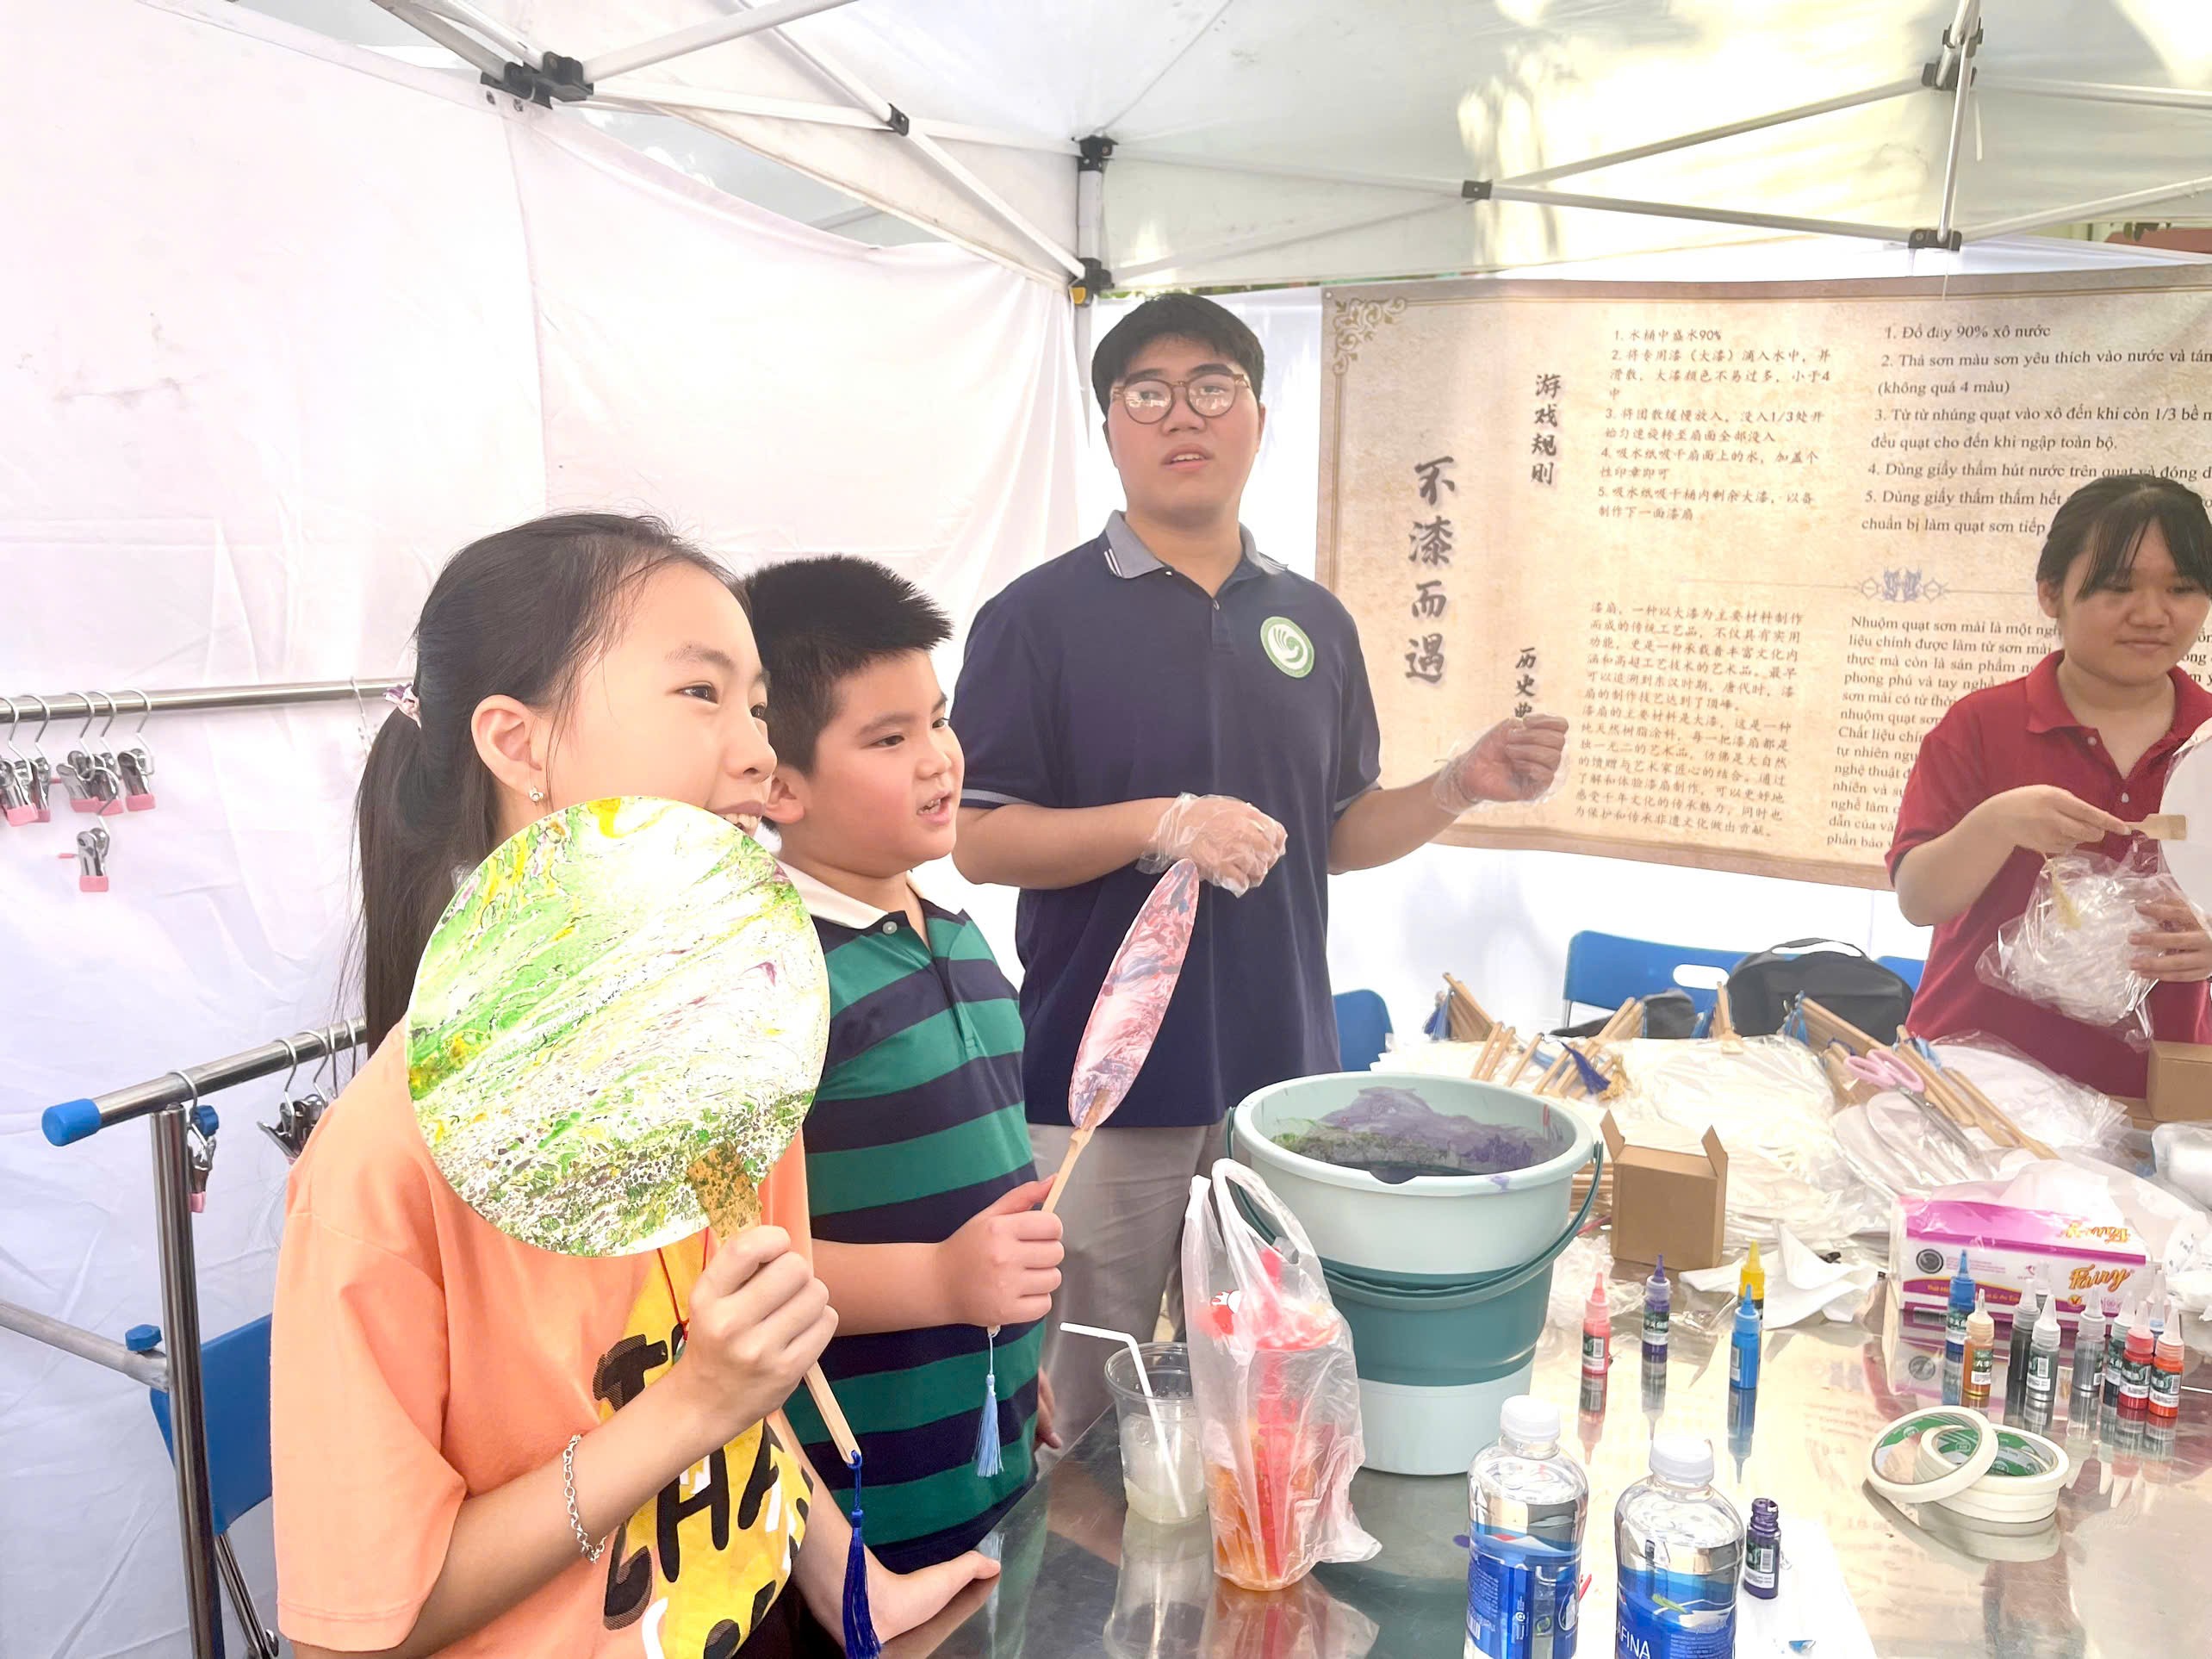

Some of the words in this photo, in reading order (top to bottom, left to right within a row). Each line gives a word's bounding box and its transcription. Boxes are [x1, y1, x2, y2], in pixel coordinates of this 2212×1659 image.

[1886, 326, 1896, 339] 1.
[1957, 325, 1988, 339] 90%
[1992, 324, 2010, 338] xô
[2015, 324, 2051, 337] nước
[1880, 353, 1893, 367] 2.
[1929, 356, 1954, 366] sơn
[1960, 353, 1989, 366] màu
[1993, 355, 2019, 366] sơn
[2023, 351, 2049, 368] yêu
[2055, 351, 2091, 363] thích
[2097, 349, 2122, 363] vào
[2128, 348, 2164, 362] nước
[2170, 348, 2185, 362] và
[1878, 382, 1926, 396] (không
[1930, 380, 1955, 396] quá
[1960, 382, 1968, 393] 4
[1973, 380, 2010, 395] màu)
[1874, 408, 1886, 421] 3.
[1932, 407, 1977, 423] nhúng
[1979, 409, 2010, 423] quạt
[2015, 406, 2041, 419] vào
[2044, 406, 2062, 419] xô
[2066, 403, 2092, 420] đến
[2097, 407, 2119, 420] khi
[2123, 407, 2149, 420] còn
[2156, 407, 2177, 421] 1/3
[2182, 403, 2199, 420] bề
[1530, 373, 1563, 485] 游戏规则
[1871, 432, 1895, 448] đều
[1900, 438, 1929, 451] quạt
[1934, 435, 1960, 448] cho
[1963, 432, 1989, 448] đến
[1994, 434, 2016, 448] khi
[2021, 435, 2055, 451] ngập
[2060, 436, 2091, 449] toàn
[2096, 436, 2117, 451] bộ.
[1867, 463, 1880, 475] 4.
[1886, 463, 1923, 479] Dùng
[1927, 459, 1958, 479] giấy
[1962, 459, 1998, 476] thấm
[2002, 462, 2024, 476] hút
[2029, 464, 2065, 477] nước
[2070, 464, 2097, 477] trên
[1865, 490, 1877, 503] 5.
[1883, 490, 1920, 506] Dùng
[1923, 487, 1954, 506] giấy
[1960, 488, 1994, 504] thấm
[1999, 488, 2034, 505] thấm
[2040, 489, 2060, 505] hết
[1906, 518, 1919, 532] bị
[1924, 517, 1949, 531] làm
[1954, 522, 1985, 534] quạt
[1989, 522, 2014, 532] sơn
[2019, 517, 2046, 536] tiếp
[1404, 455, 1456, 684] 不漆而遇
[1852, 616, 1898, 630] Nhuộm
[1902, 620, 1929, 633] quạt
[1934, 621, 1956, 632] sơn
[1961, 620, 1985, 633] mài
[1991, 621, 2001, 634] là
[2006, 623, 2031, 637] một
[2036, 624, 2062, 638] ngh
[1849, 634, 1872, 647] liệu
[1876, 635, 1911, 649] chính
[1915, 637, 1948, 652] được
[1953, 638, 1976, 651] làm
[1998, 643, 2022, 654] sơn
[1847, 652, 1874, 666] thực
[1880, 655, 1898, 667] mà
[1904, 656, 1928, 668] còn
[1934, 656, 1945, 668] là
[1844, 671, 1884, 687] phong
[1888, 674, 1912, 688] phú
[1918, 675, 1932, 687] và
[1938, 678, 1957, 692] tay
[1842, 692, 1864, 702] sơn
[1868, 691, 1892, 704] mài
[1895, 693, 1911, 705] có
[1841, 708, 1884, 723] nhuộm
[1888, 713, 1916, 726] quạt
[1838, 724, 1868, 739] Chất
[1872, 728, 1895, 742] liệu
[1855, 747, 1888, 759] nhiên
[1835, 763, 1865, 778] nghệ
[1868, 765, 1899, 780] thuật
[1873, 783, 1886, 795] và
[1866, 800, 1888, 813] làm
[2068, 1264, 2131, 1293] Fairy
